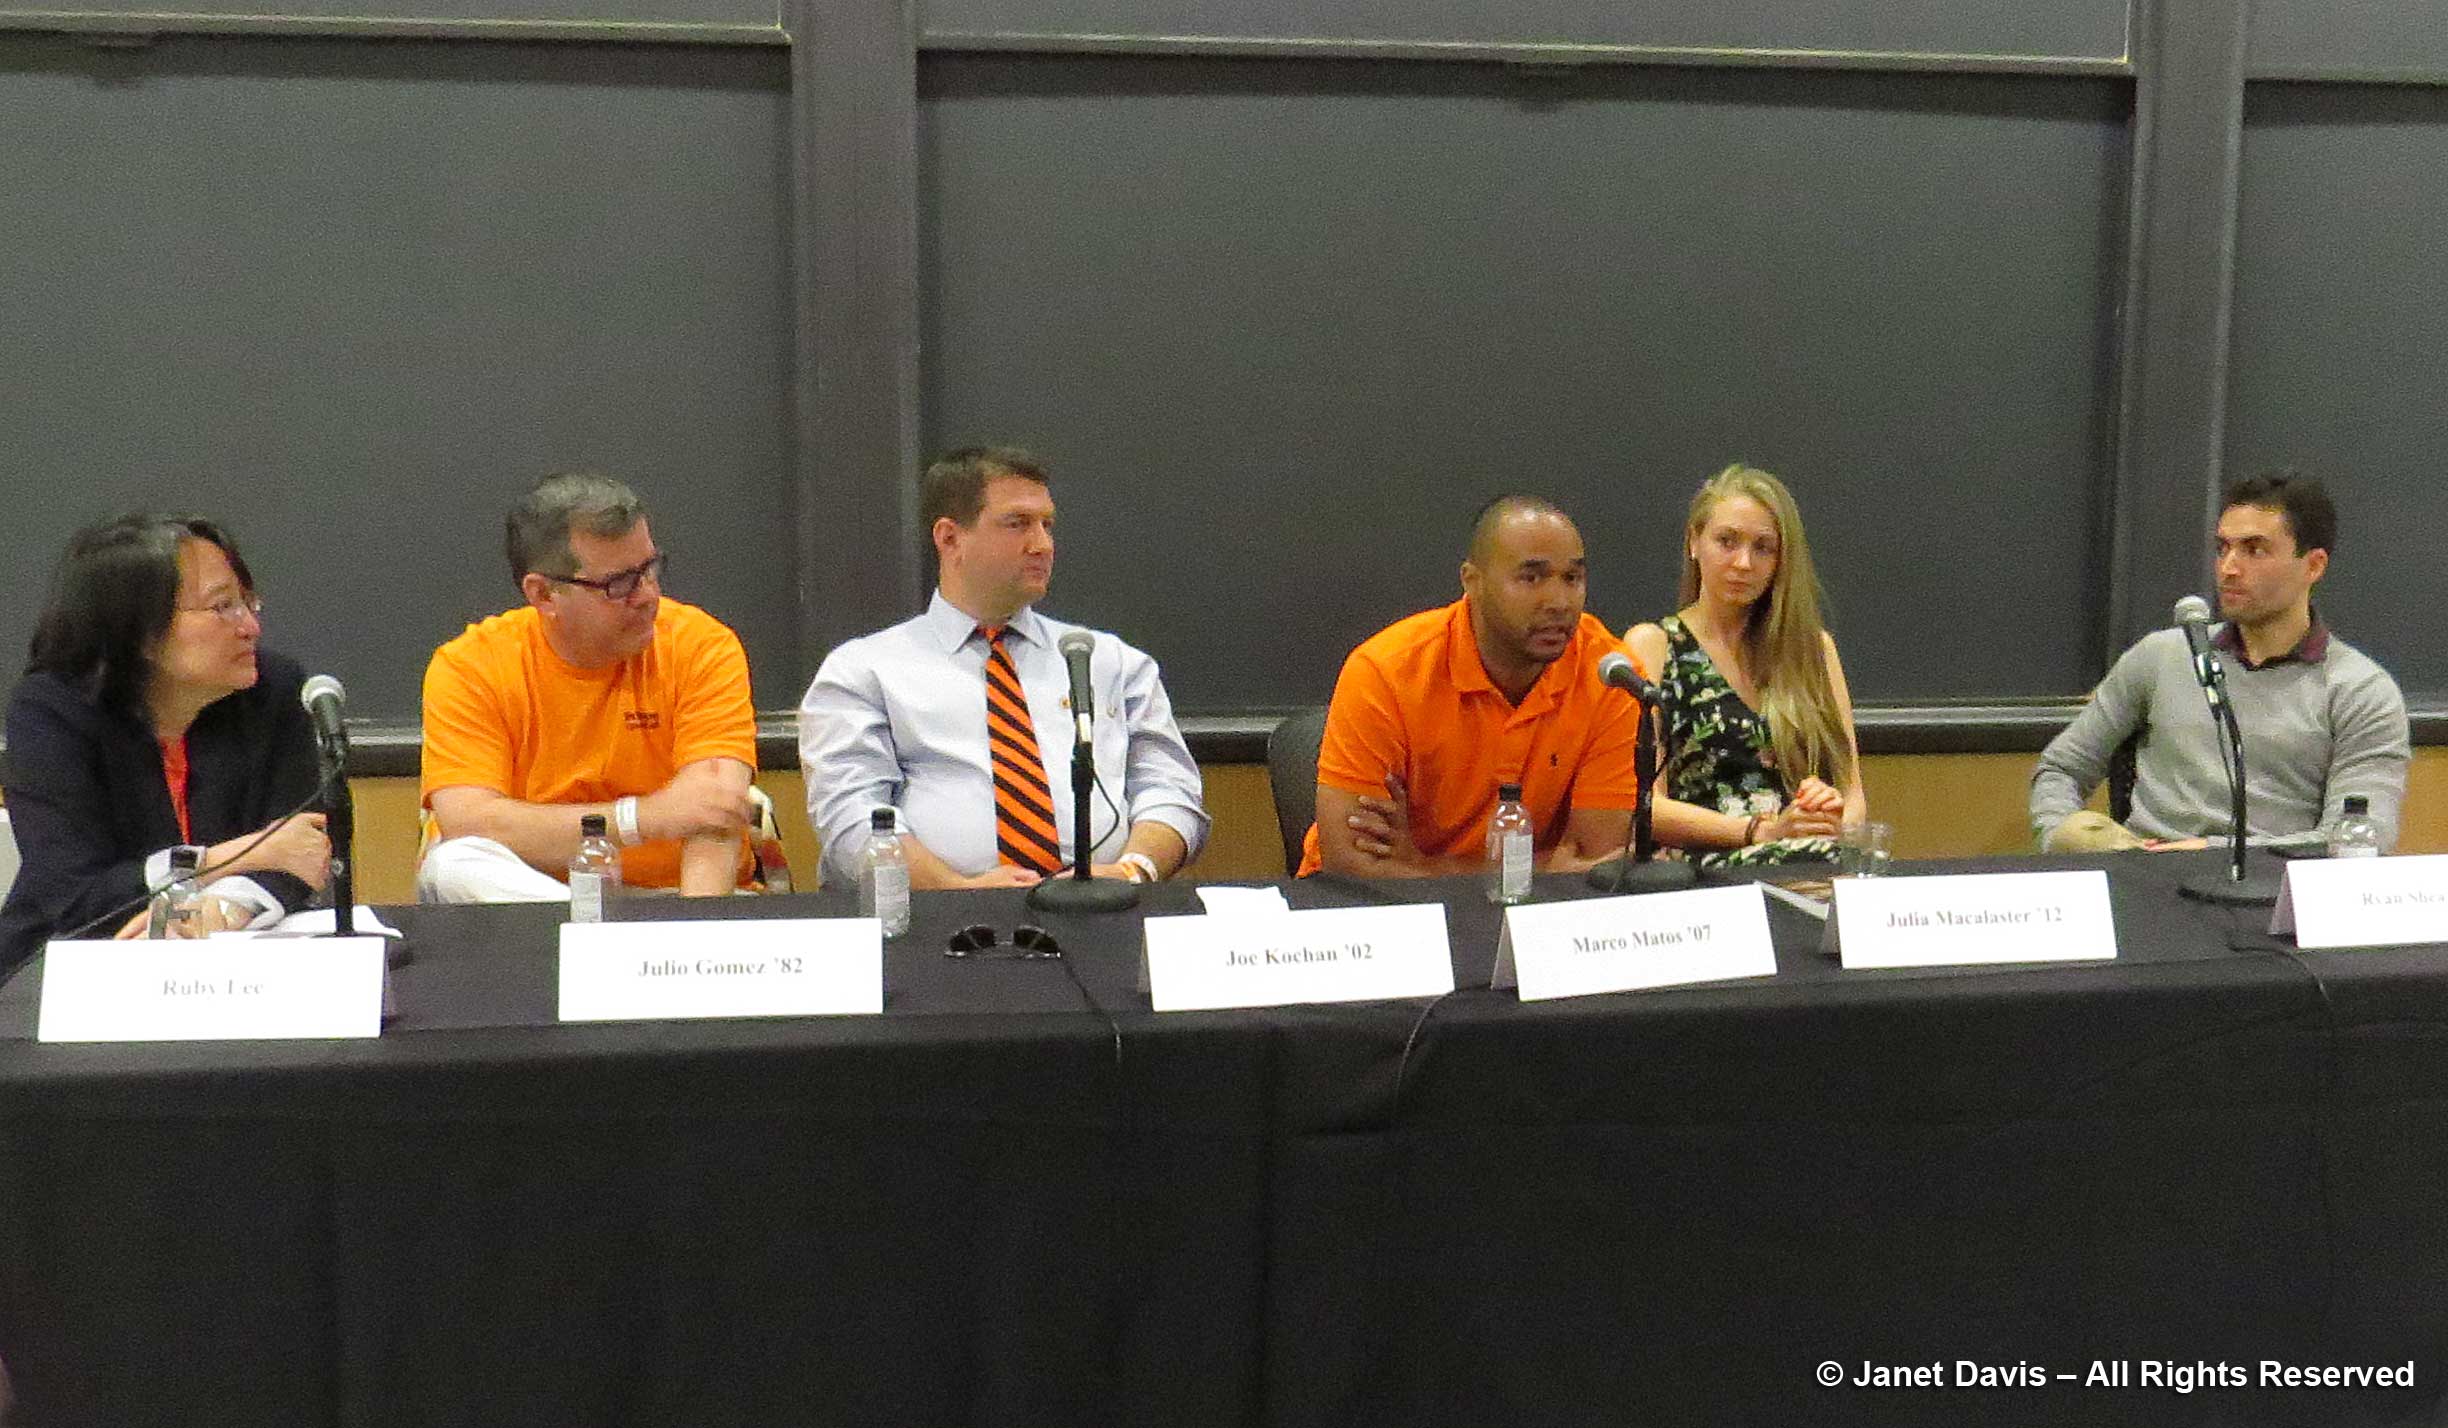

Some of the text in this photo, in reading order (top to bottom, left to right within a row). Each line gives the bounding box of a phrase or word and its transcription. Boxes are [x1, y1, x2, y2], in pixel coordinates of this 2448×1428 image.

[2360, 891, 2404, 910] Ryan
[1886, 911, 1929, 928] Julia
[1936, 908, 2031, 926] Macalaster
[1572, 924, 1711, 955] Marco Matos ’07
[1226, 943, 1373, 967] Joe Kochan ’02
[637, 957, 803, 977] Julio Gomez ’82
[163, 978, 264, 1000] Ruby Lee
